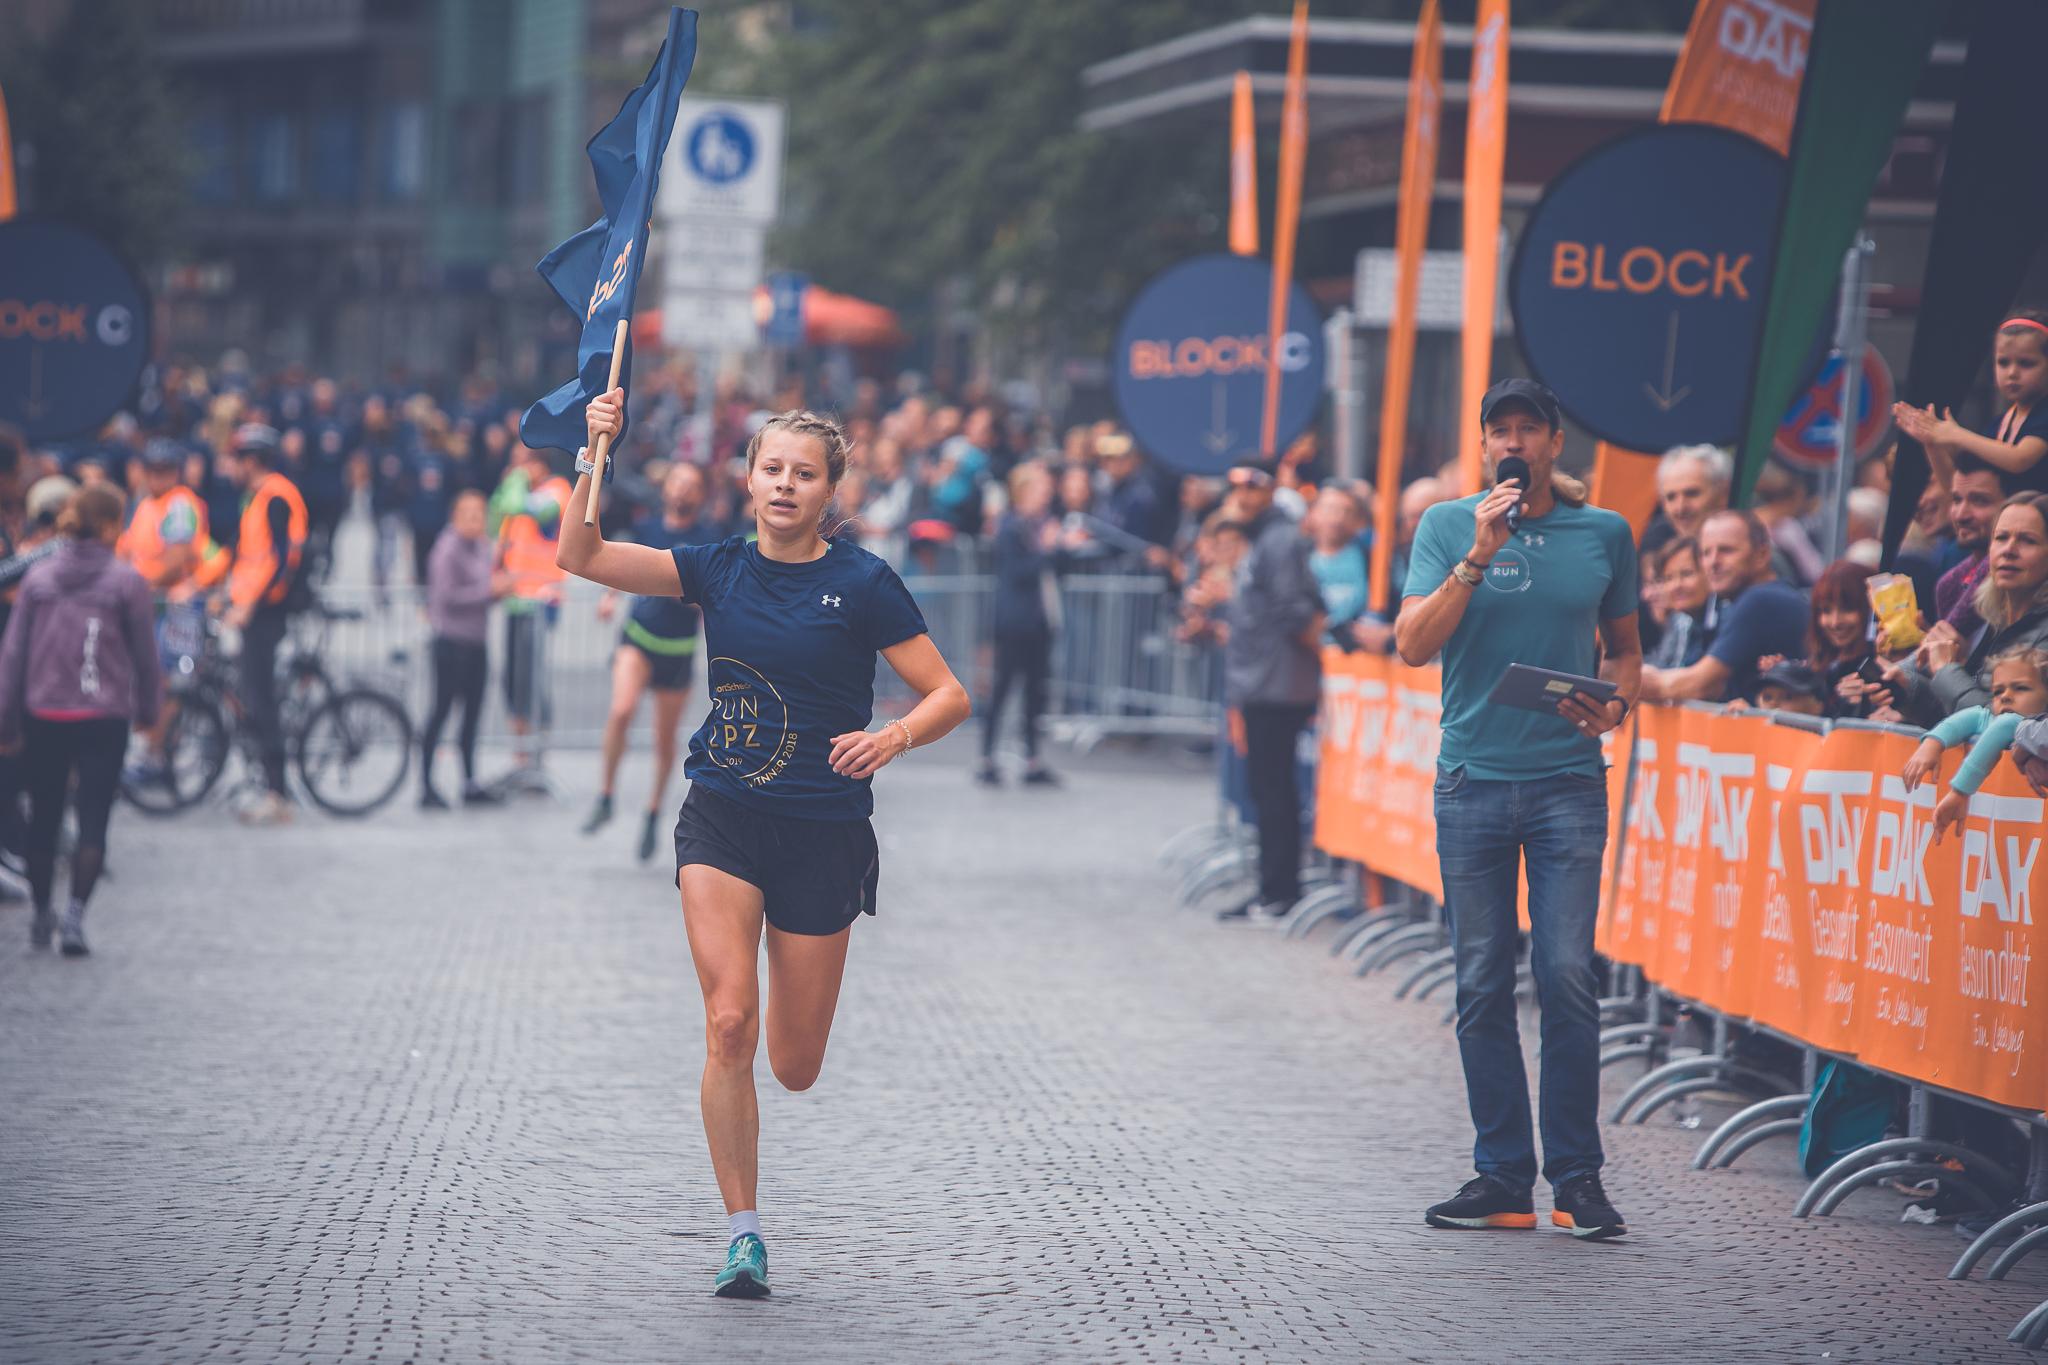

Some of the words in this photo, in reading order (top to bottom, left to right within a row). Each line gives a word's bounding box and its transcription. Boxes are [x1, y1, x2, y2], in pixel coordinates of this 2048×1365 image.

[1552, 241, 1752, 299] BLOCK
[0, 299, 87, 343] OCK
[1130, 334, 1268, 380] BLOCK
[1276, 331, 1311, 372] C
[1493, 567, 1519, 576] RUN
[782, 732, 798, 760] 2018
[1800, 769, 1873, 888] DAK
[1871, 775, 1937, 906] DAK
[1960, 792, 2044, 925] DAK
